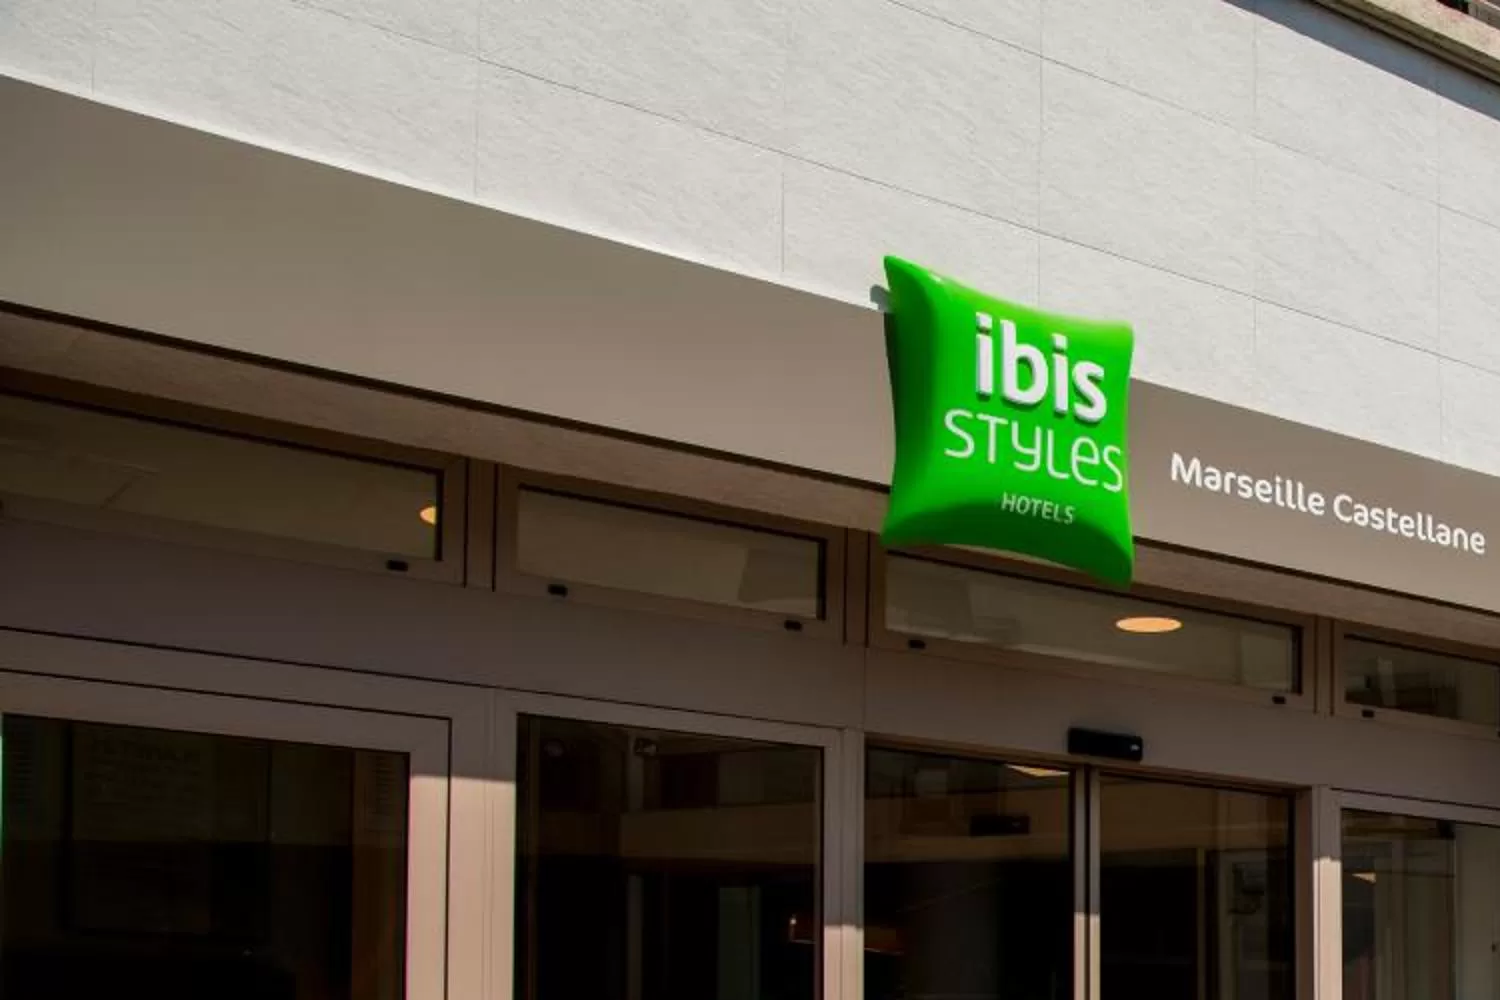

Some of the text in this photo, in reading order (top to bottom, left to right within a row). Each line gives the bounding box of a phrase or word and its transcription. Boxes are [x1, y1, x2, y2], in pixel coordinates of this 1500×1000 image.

[975, 311, 1107, 424] ibis
[1000, 491, 1076, 524] HOTELS
[1170, 451, 1486, 554] Marseille Castellane
